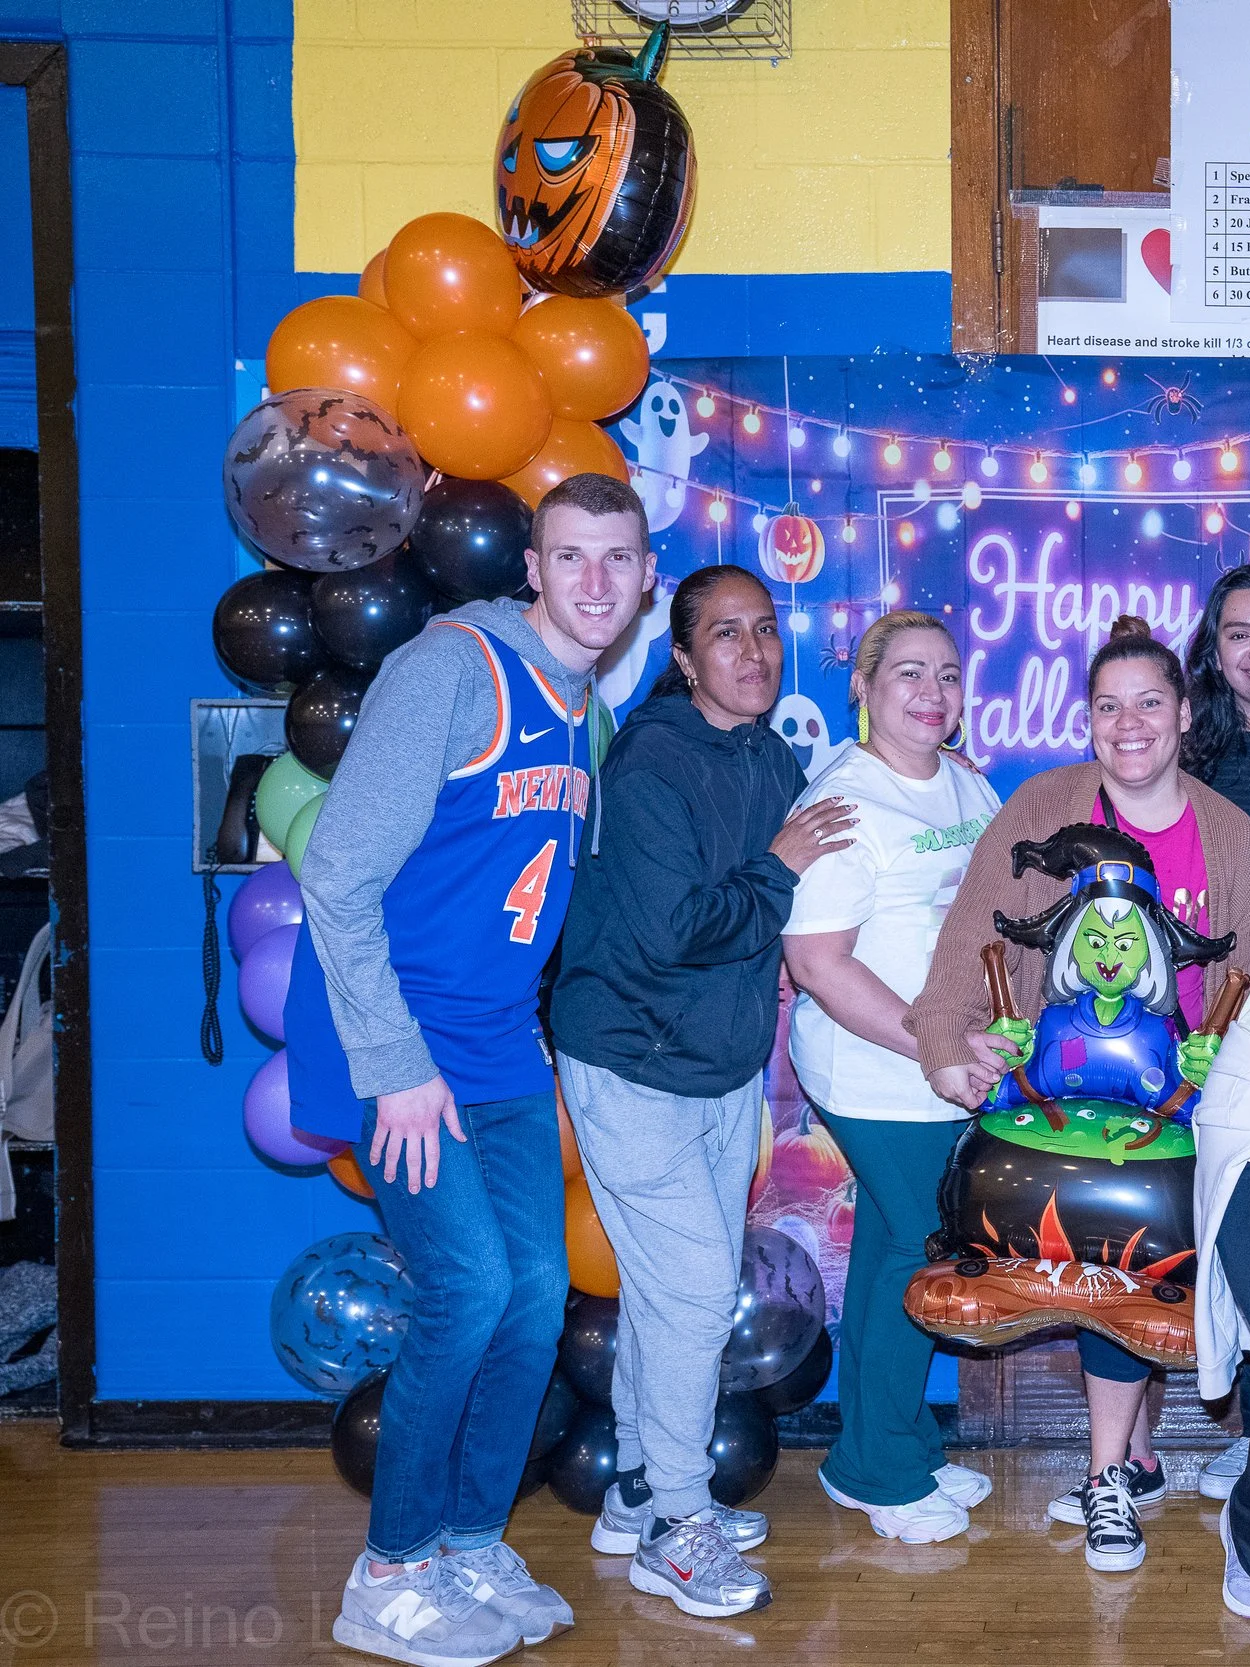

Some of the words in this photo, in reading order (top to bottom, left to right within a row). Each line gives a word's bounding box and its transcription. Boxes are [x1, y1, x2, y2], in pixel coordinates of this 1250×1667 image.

[1212, 170, 1219, 181] 1
[1212, 194, 1219, 204] 2
[1212, 217, 1219, 228] 3
[1230, 217, 1243, 228] 20
[1212, 241, 1219, 252] 4
[1231, 241, 1243, 252] 15
[1212, 265, 1219, 276] 5
[1212, 289, 1219, 300] 6
[1229, 289, 1243, 300] 30
[1047, 335, 1081, 346] Heart
[1083, 335, 1131, 347] disease
[1134, 337, 1158, 348] and
[1161, 337, 1200, 349] stroke
[1203, 337, 1221, 349] kill
[1225, 337, 1243, 349] 1/3
[969, 532, 1204, 669] Happy
[492, 764, 565, 819] NEW
[503, 839, 557, 944] 4
